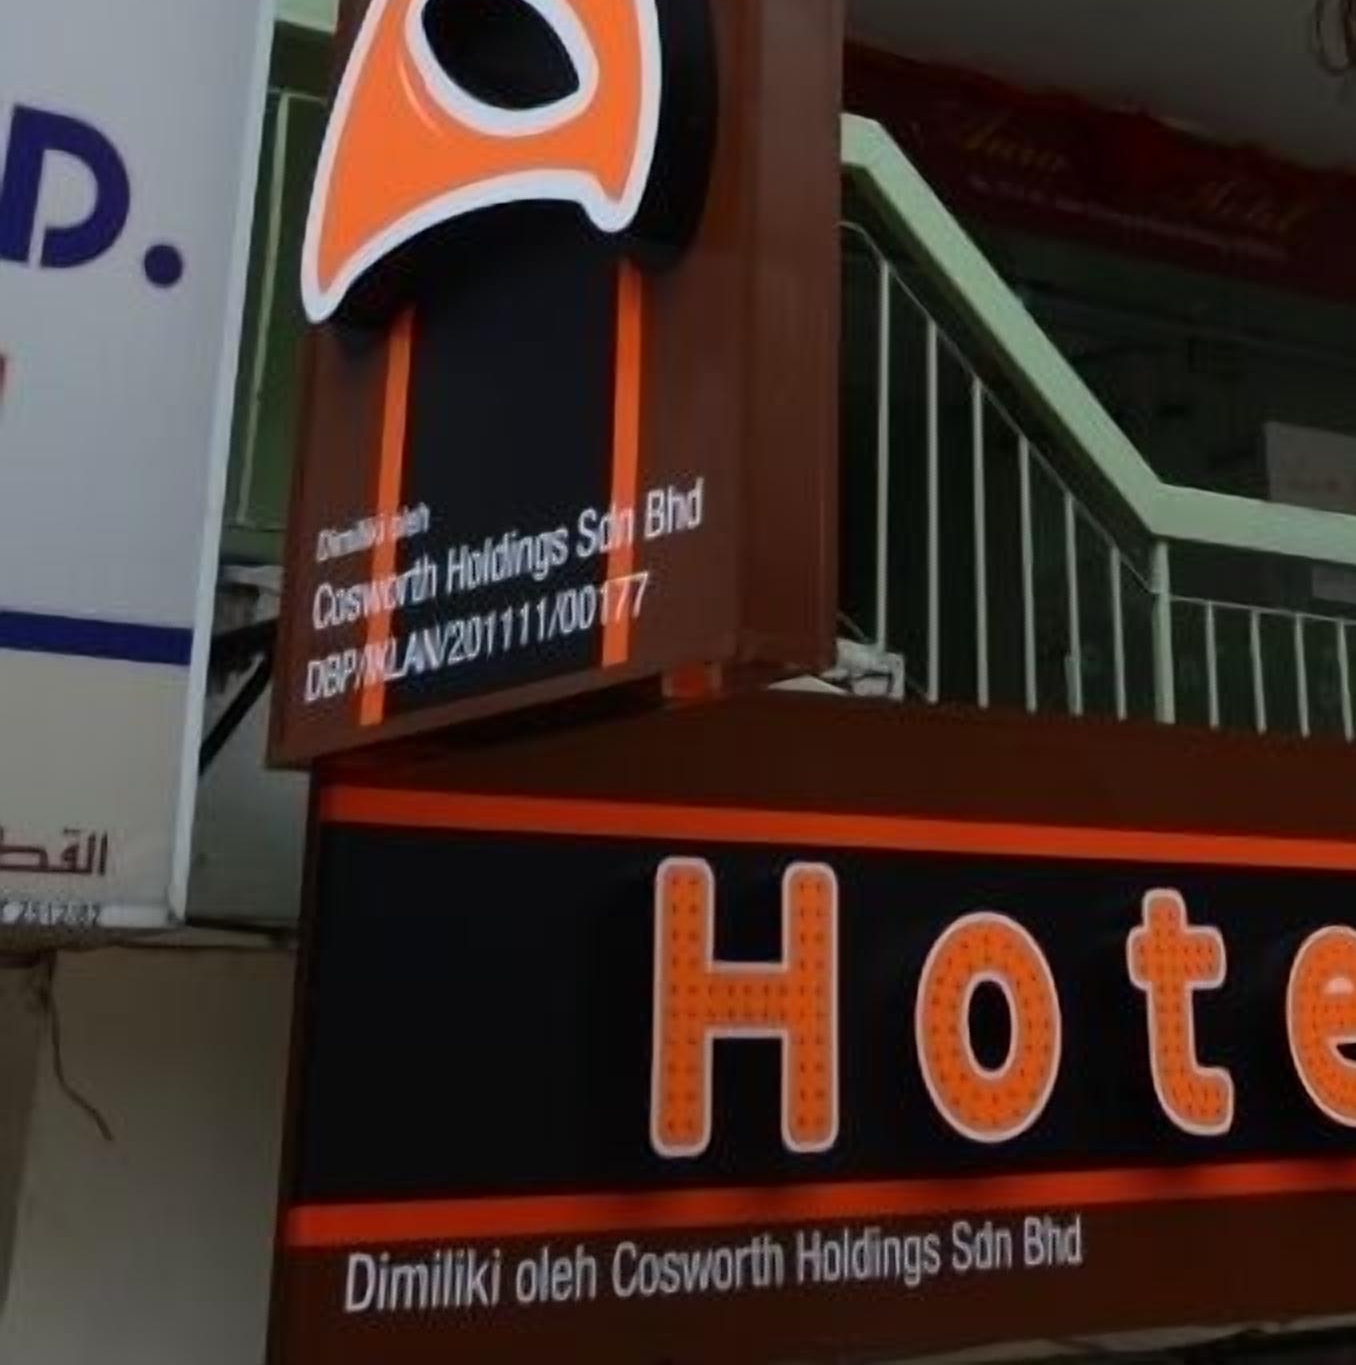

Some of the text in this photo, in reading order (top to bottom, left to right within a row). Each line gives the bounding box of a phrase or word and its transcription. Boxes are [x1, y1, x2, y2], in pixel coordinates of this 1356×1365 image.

[312, 477, 705, 630] Cosworth Holdings Sdn Bhd
[344, 1215, 1083, 1314] Dimiliki oleh Cosworth Holdings Sdn Bhd
